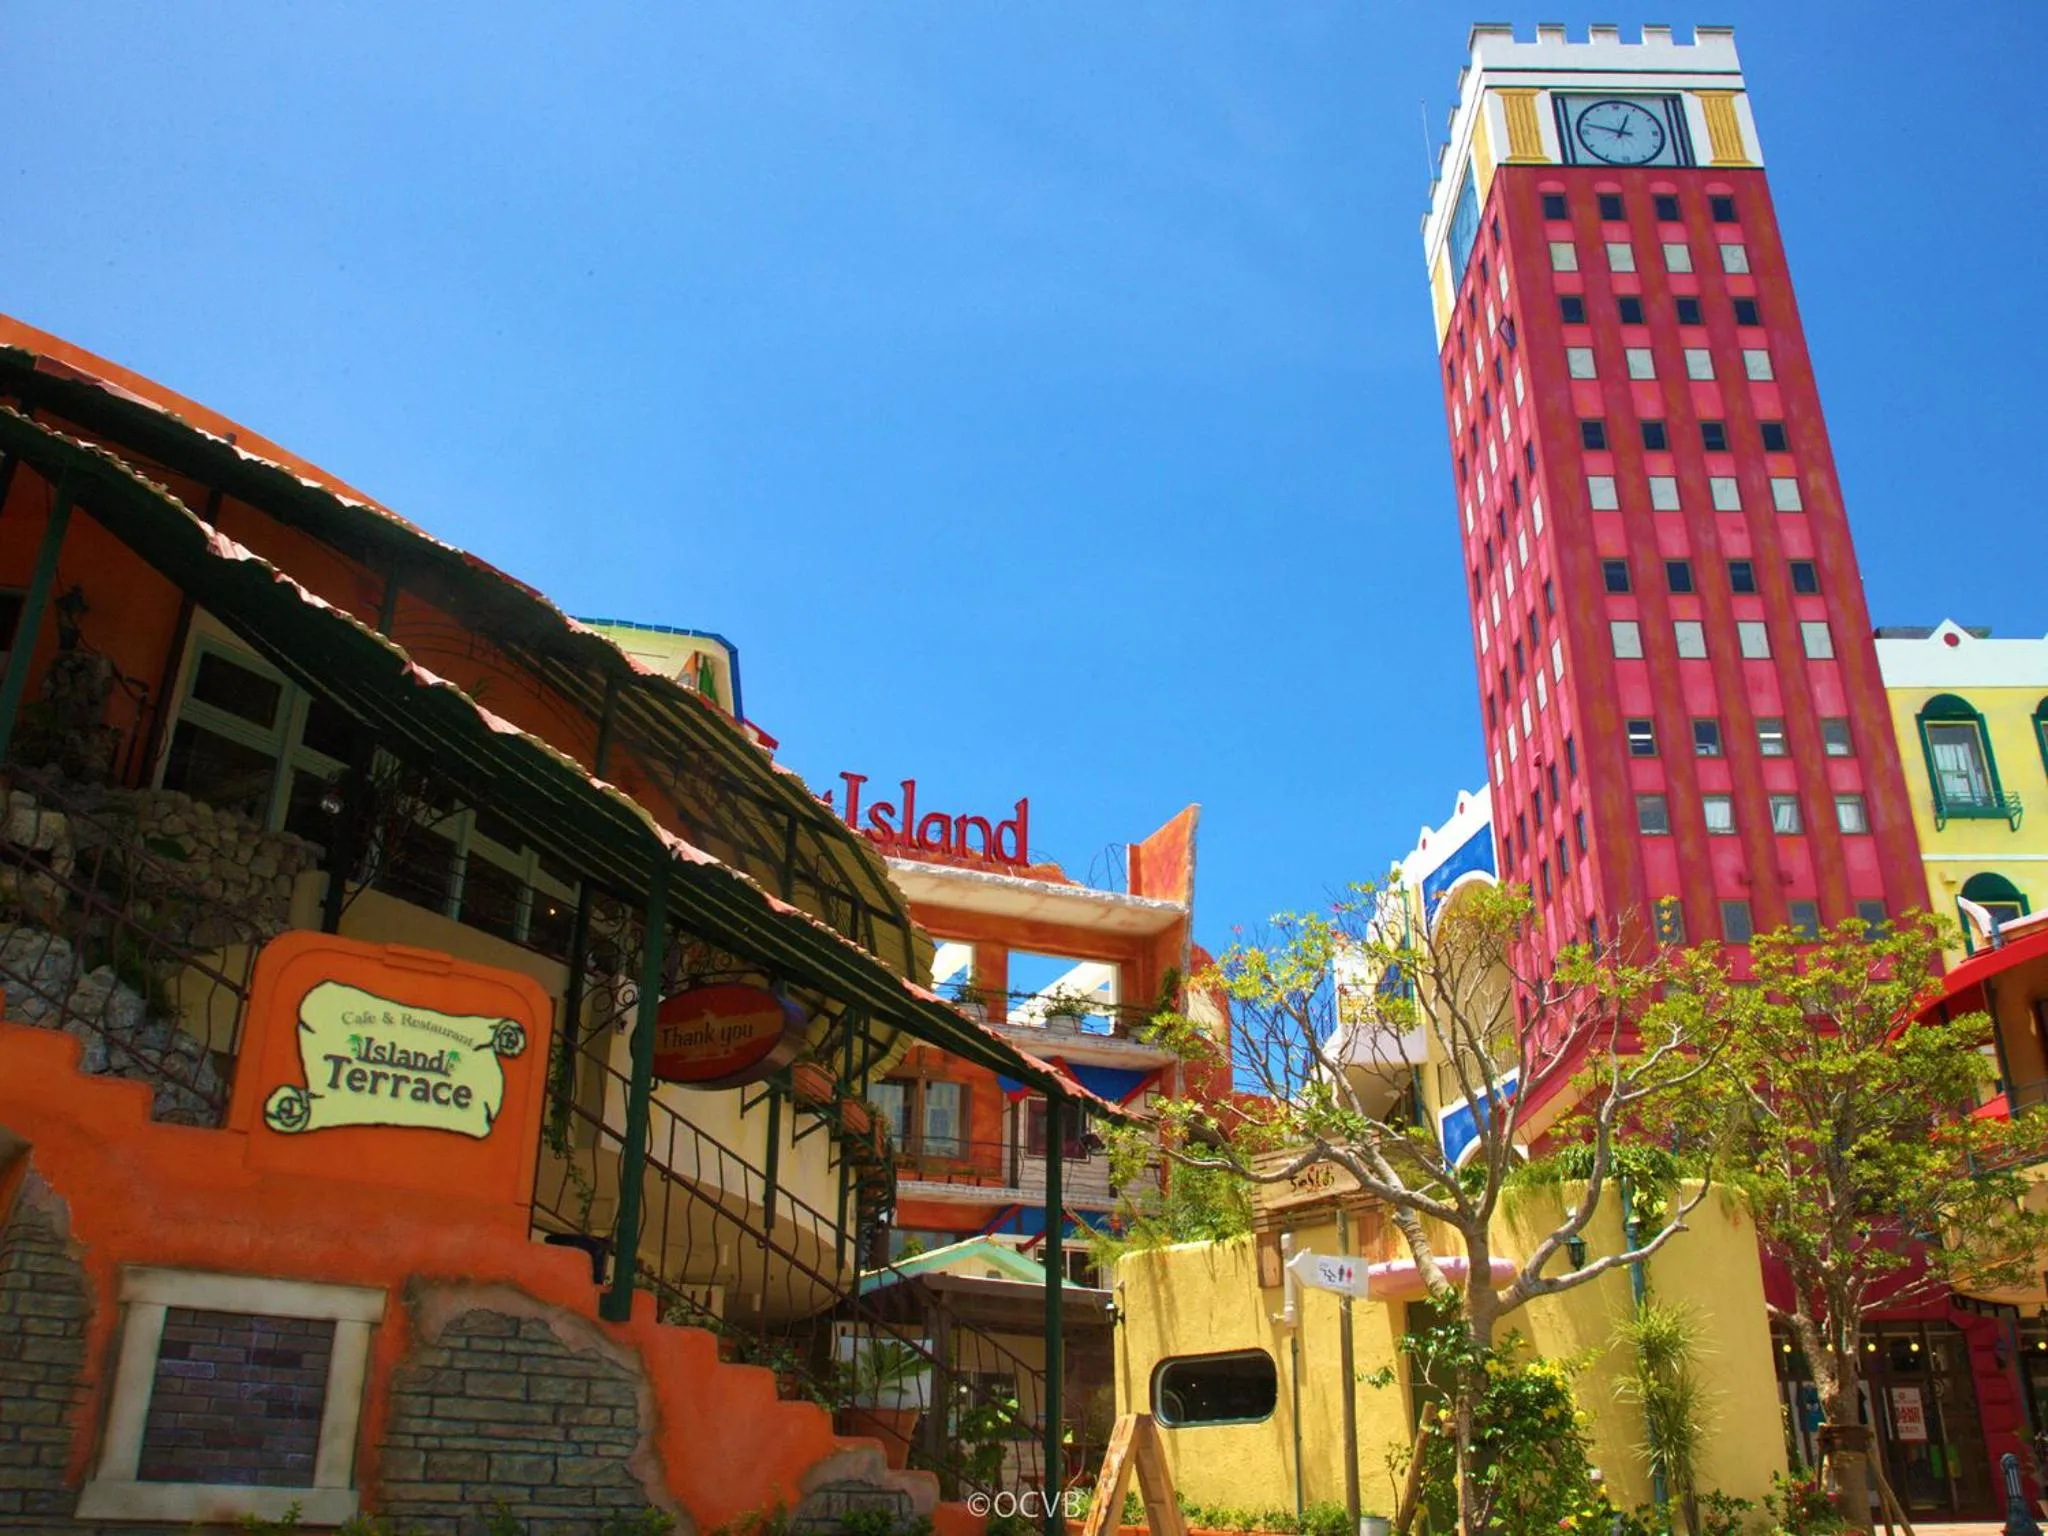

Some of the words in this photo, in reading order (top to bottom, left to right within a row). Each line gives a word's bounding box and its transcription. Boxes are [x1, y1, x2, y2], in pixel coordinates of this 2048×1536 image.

[839, 771, 1029, 867] Island
[341, 1011, 376, 1026] Cafe
[382, 1012, 394, 1025] &
[401, 1013, 474, 1048] Restaurant
[663, 1021, 714, 1048] Thank
[720, 1024, 753, 1047] you
[360, 1036, 447, 1074] Island
[323, 1053, 473, 1109] Terrace
